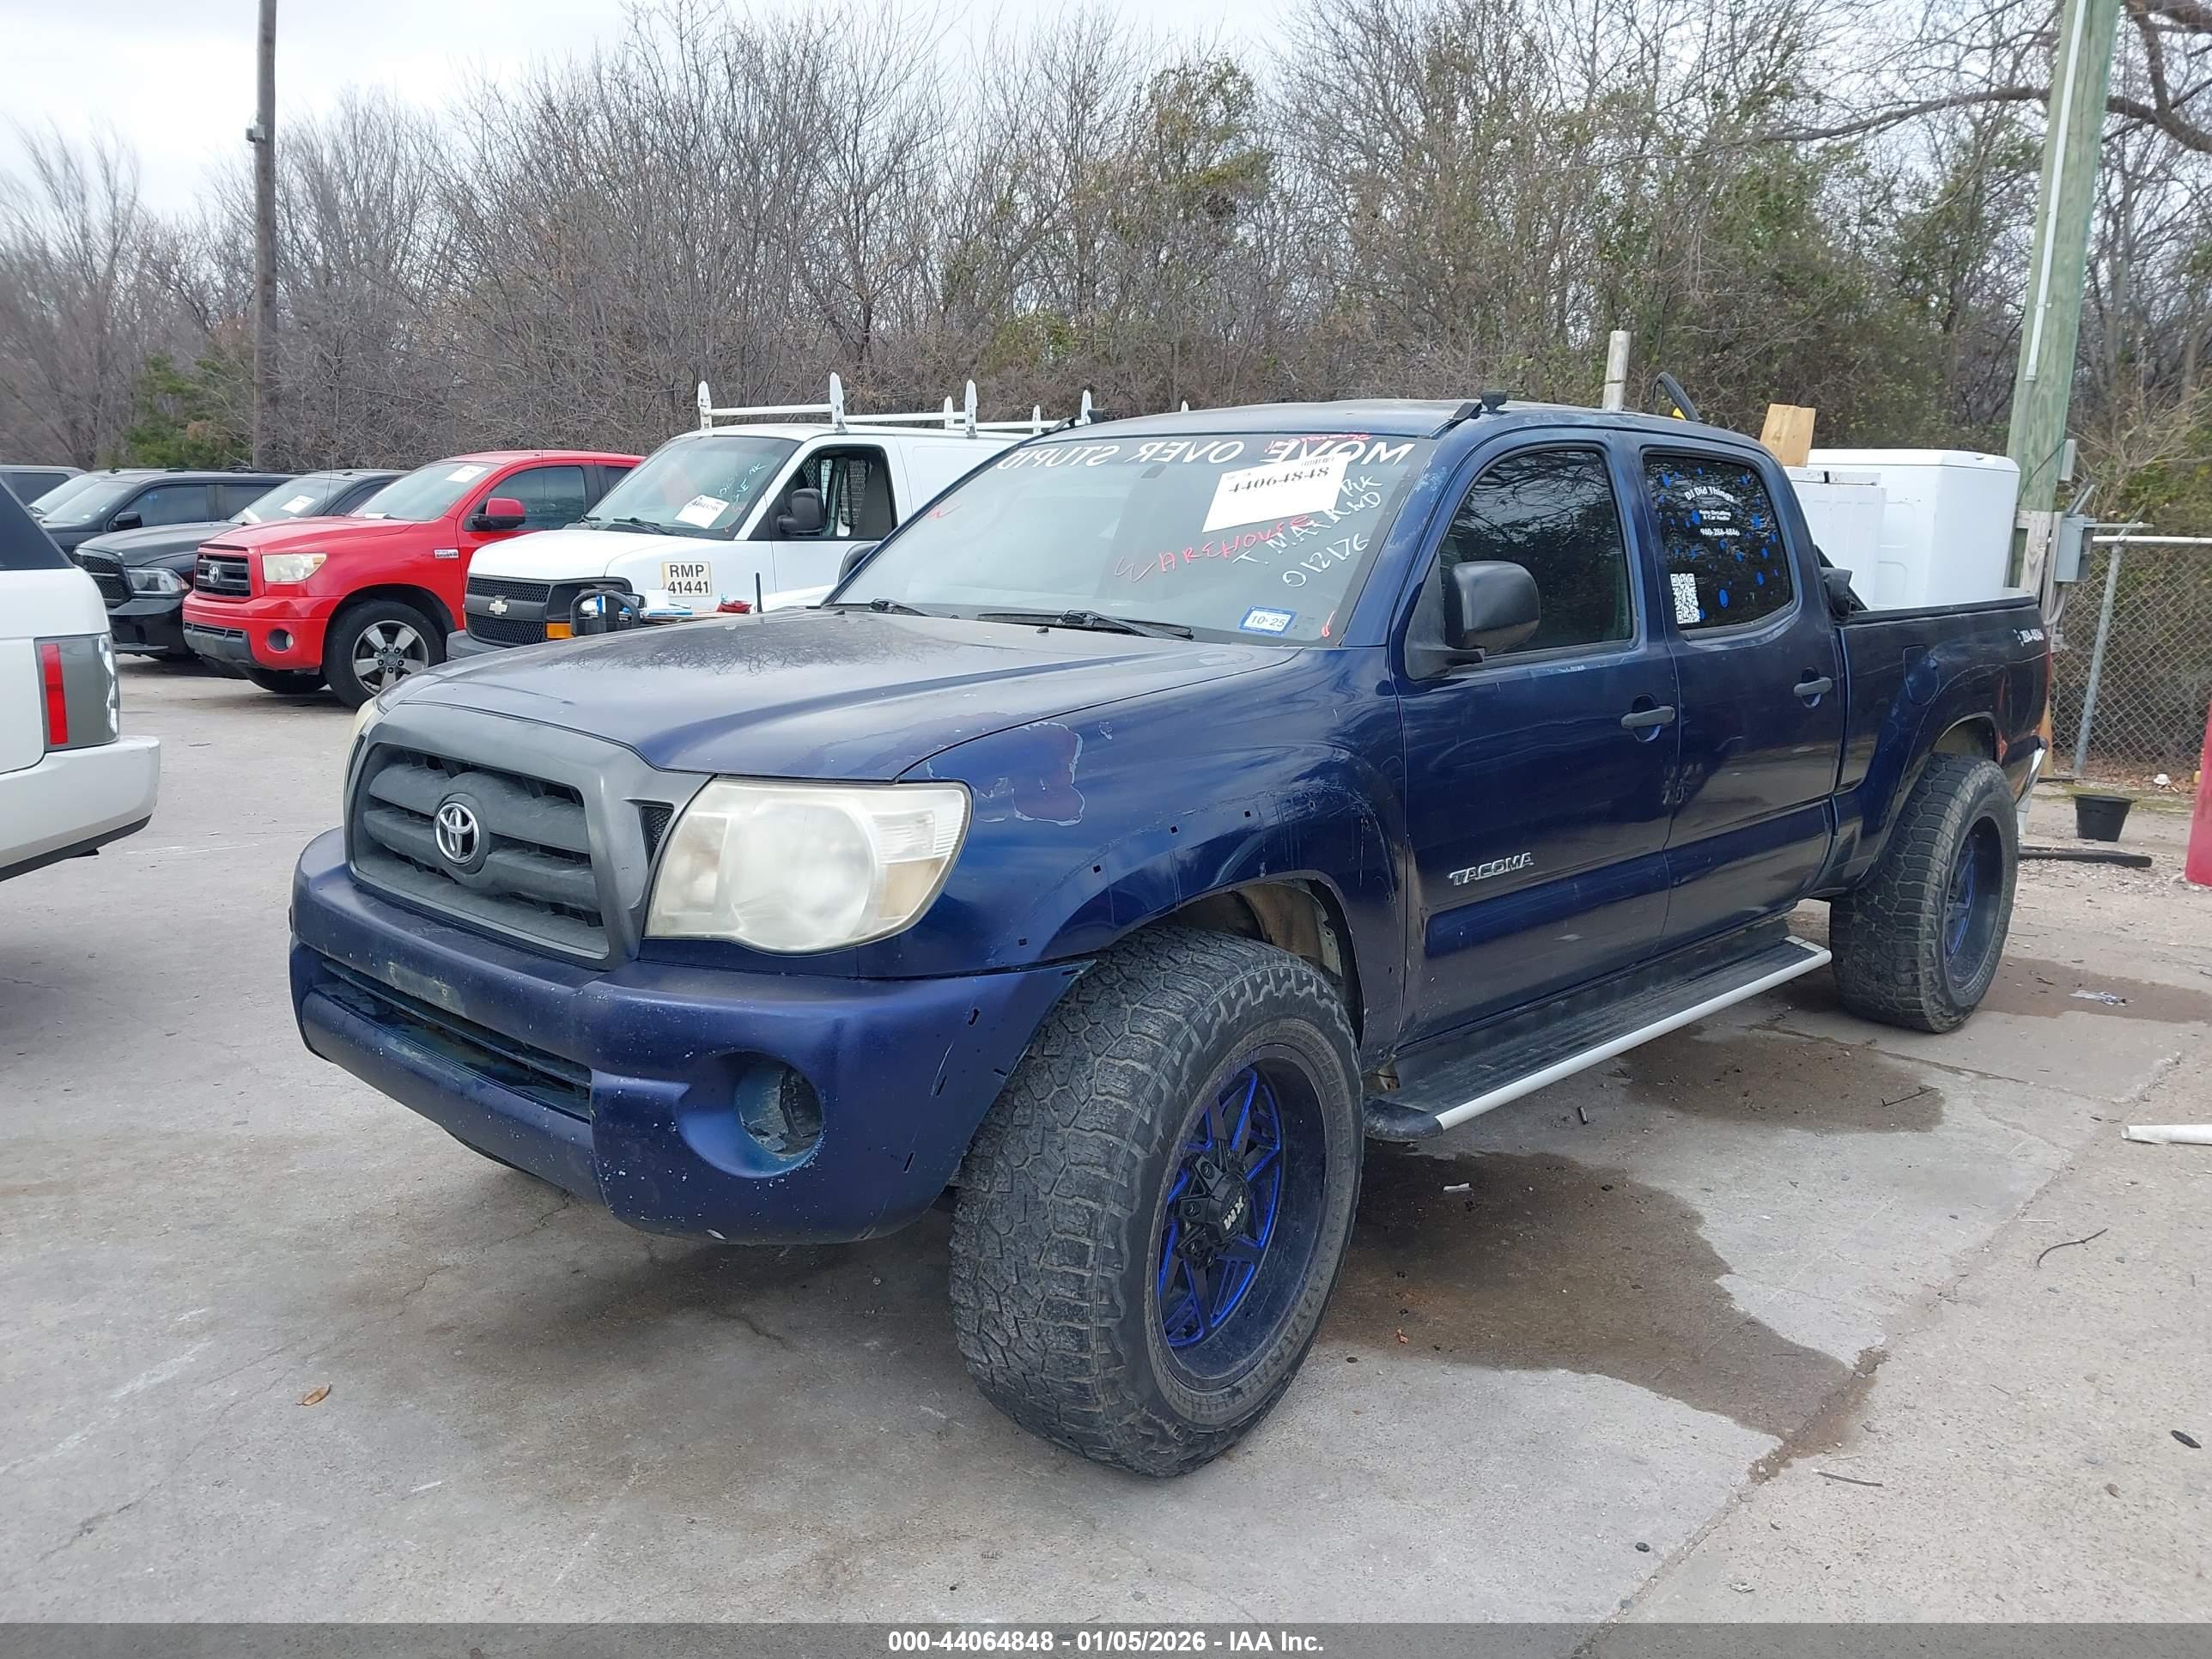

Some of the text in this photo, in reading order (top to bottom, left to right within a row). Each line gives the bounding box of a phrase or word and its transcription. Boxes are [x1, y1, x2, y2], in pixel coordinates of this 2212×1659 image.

[1229, 466, 1330, 492] 44064848
[669, 564, 705, 578] RMP
[667, 580, 708, 594] 41441
[1448, 852, 1535, 886] TACOMA
